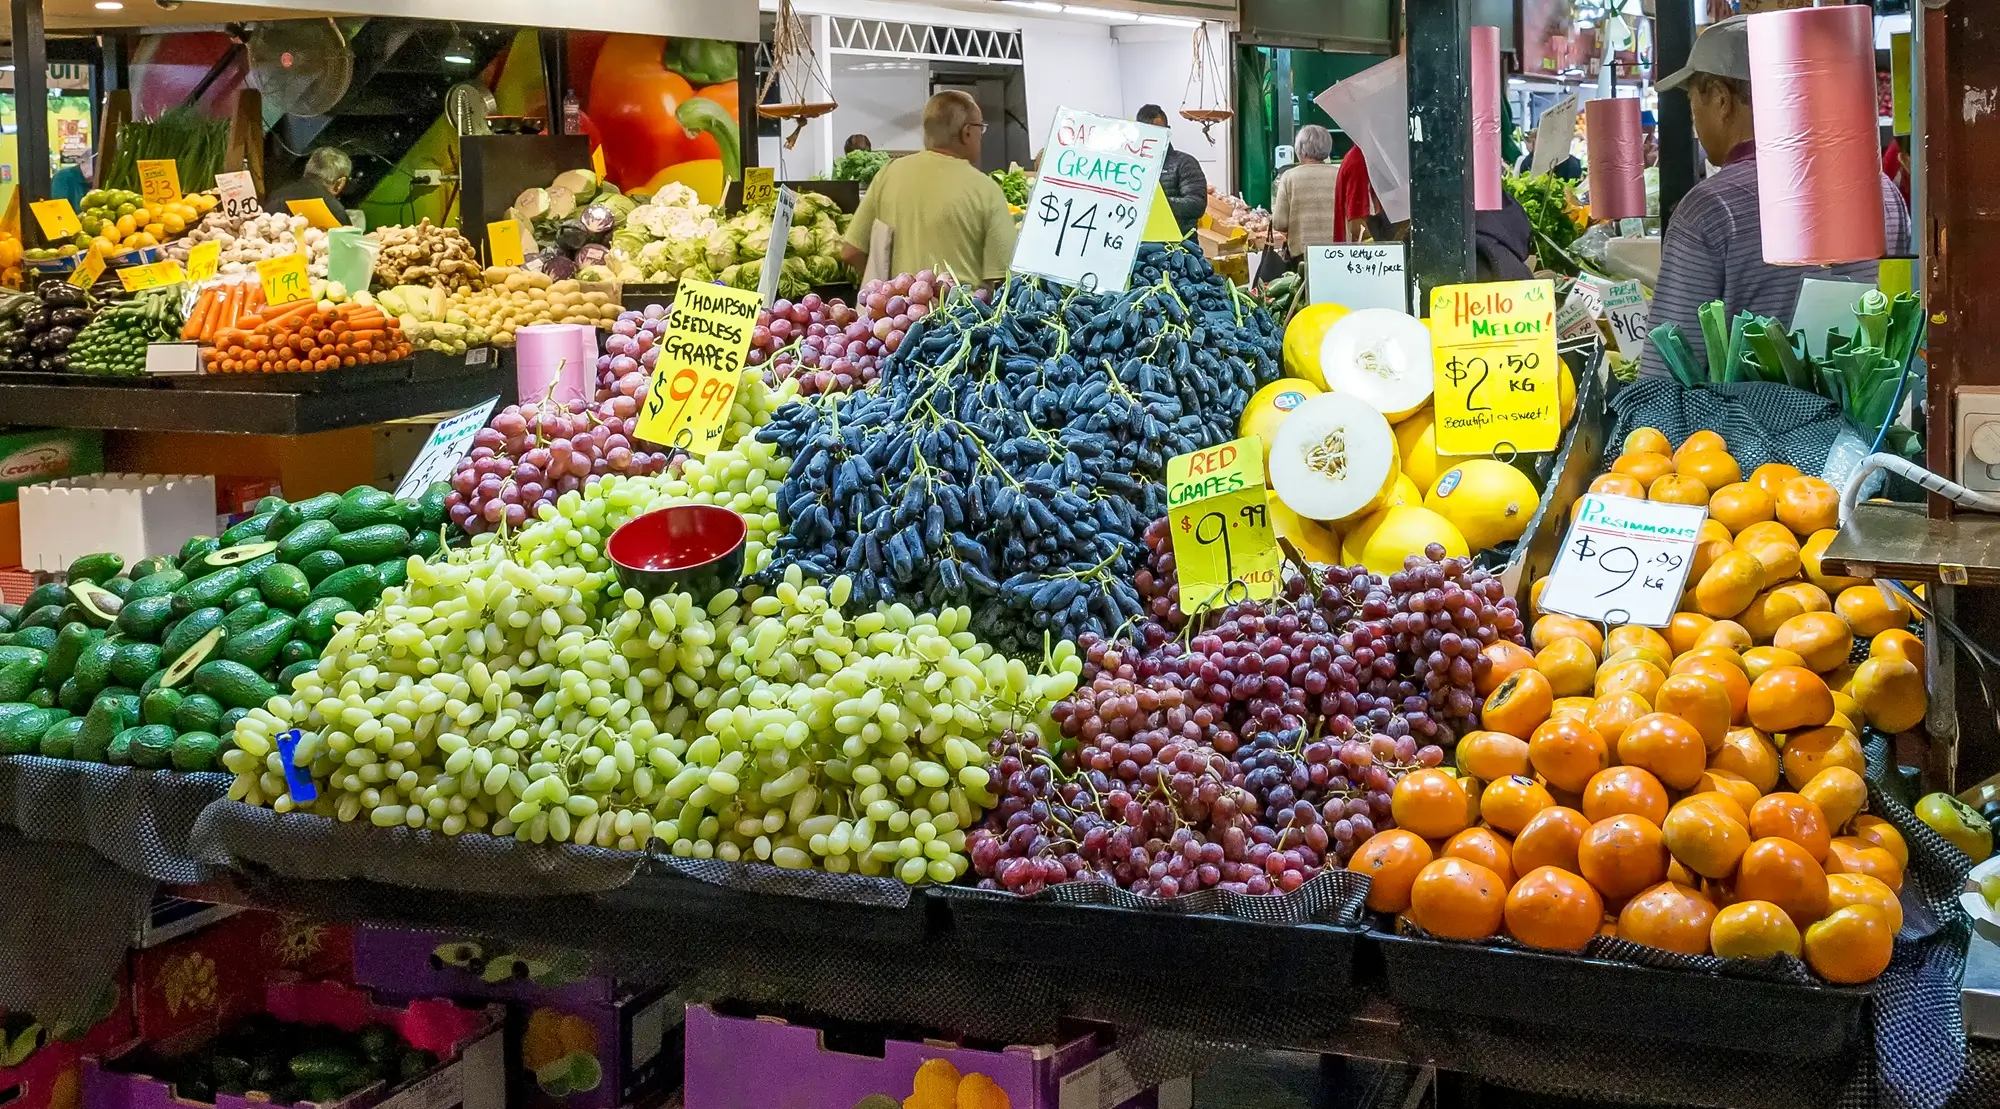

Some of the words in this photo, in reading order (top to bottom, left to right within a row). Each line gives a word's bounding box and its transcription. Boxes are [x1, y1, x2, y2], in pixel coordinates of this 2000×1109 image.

[1057, 149, 1146, 192] GRAPES
[1454, 291, 1513, 327] Hello
[670, 310, 742, 345] SEEDLESS
[665, 335, 739, 372] GRAPES
[1444, 412, 1494, 428] Beautiful
[1188, 445, 1237, 478] RED
[1169, 472, 1244, 505] GRAPES
[1580, 498, 1697, 539] PERSIMMONS
